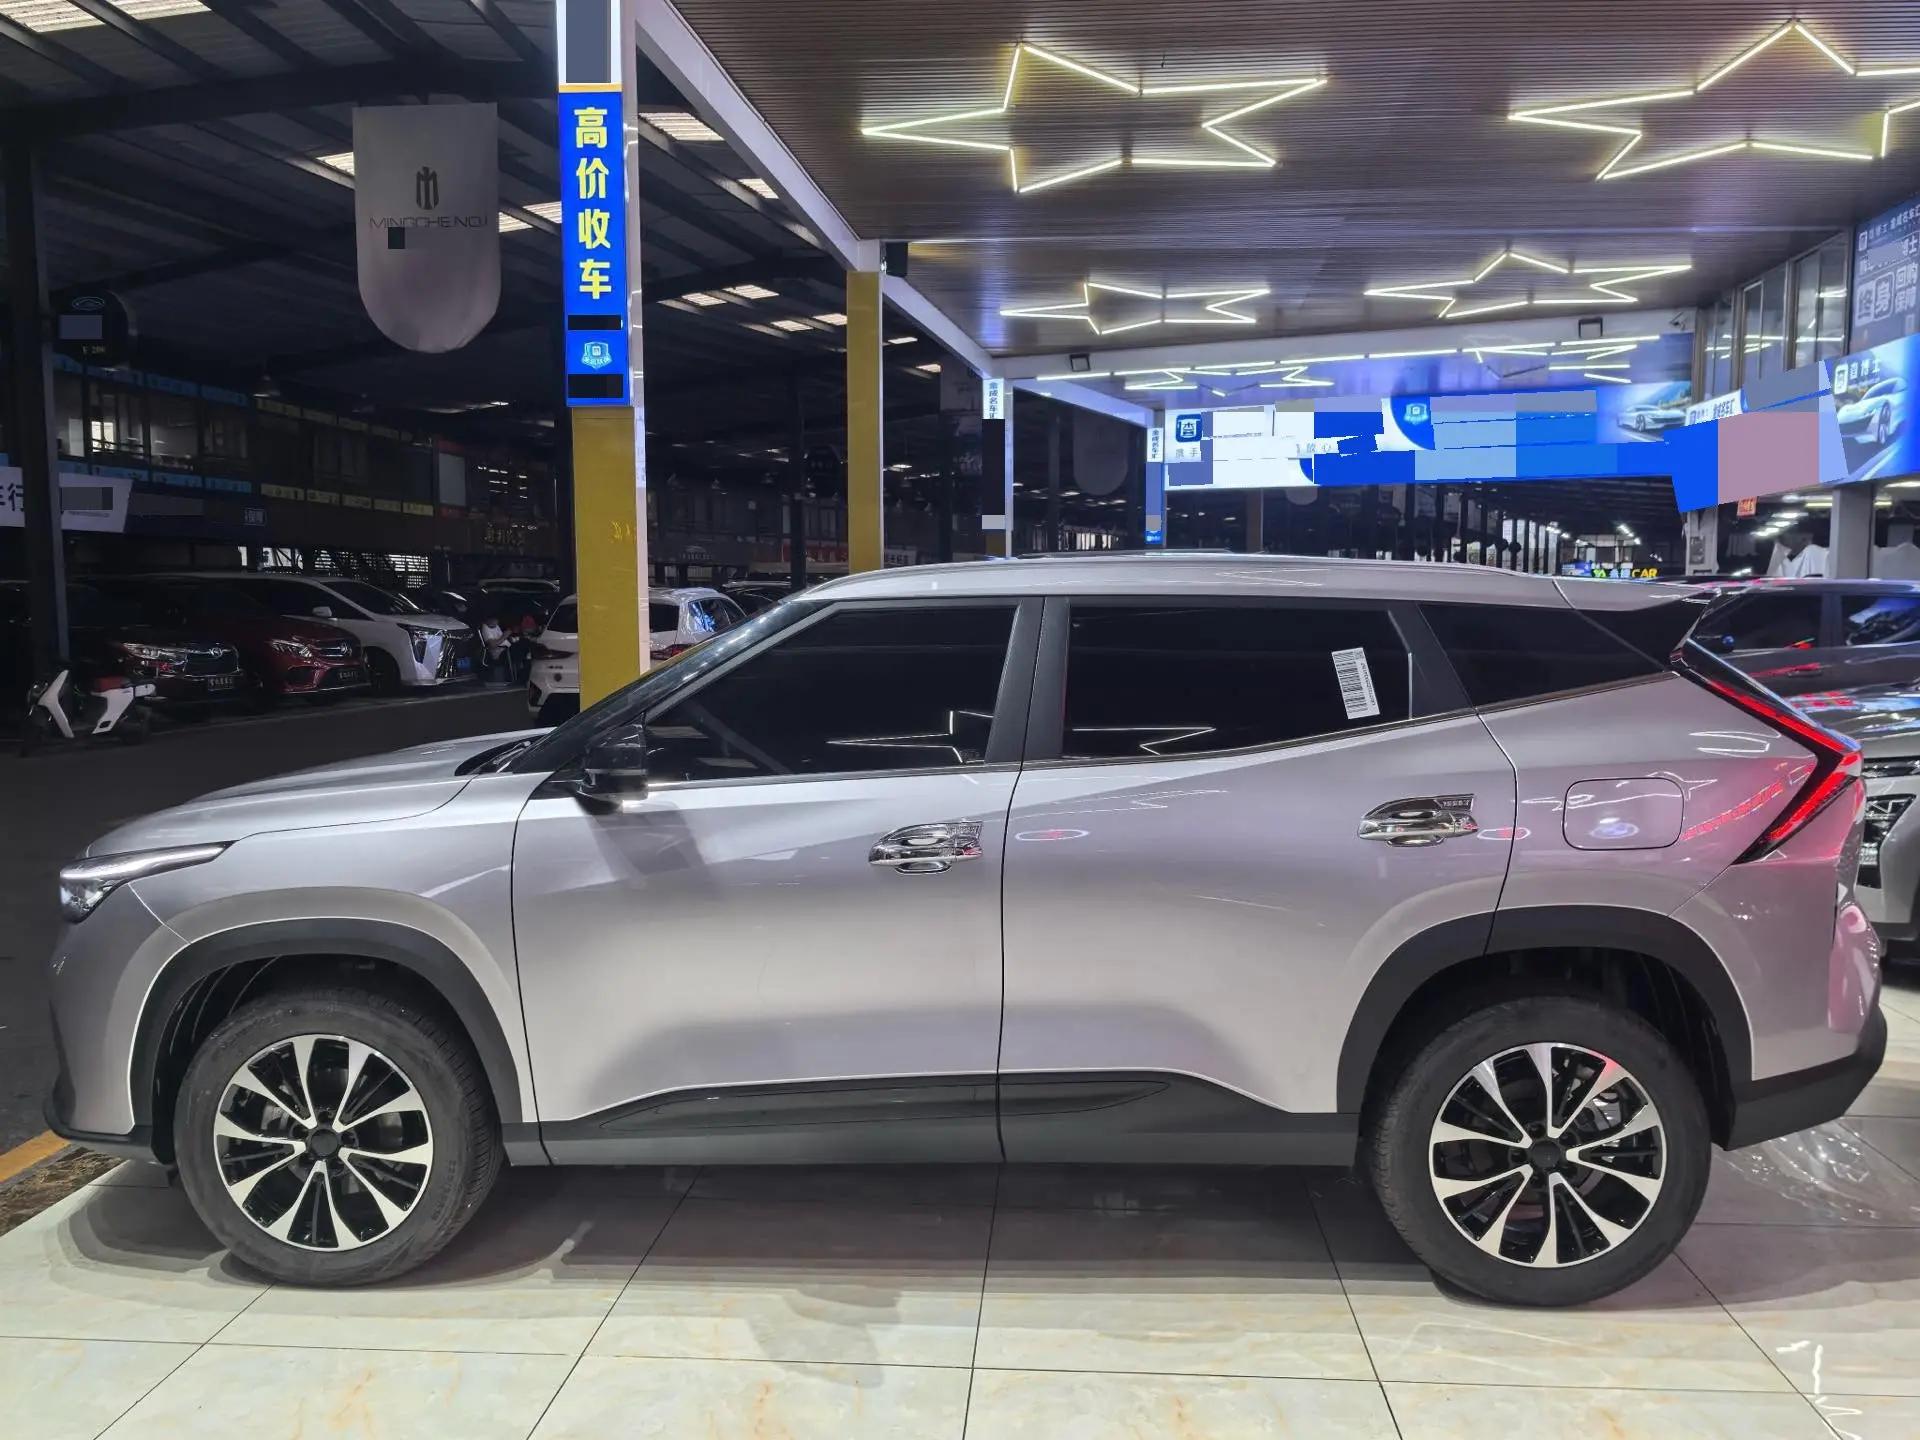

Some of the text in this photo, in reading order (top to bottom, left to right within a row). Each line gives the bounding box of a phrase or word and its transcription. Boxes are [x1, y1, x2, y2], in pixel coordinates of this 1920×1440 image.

[573, 106, 612, 300] 高价收车
[1632, 568, 1659, 578] CAR
